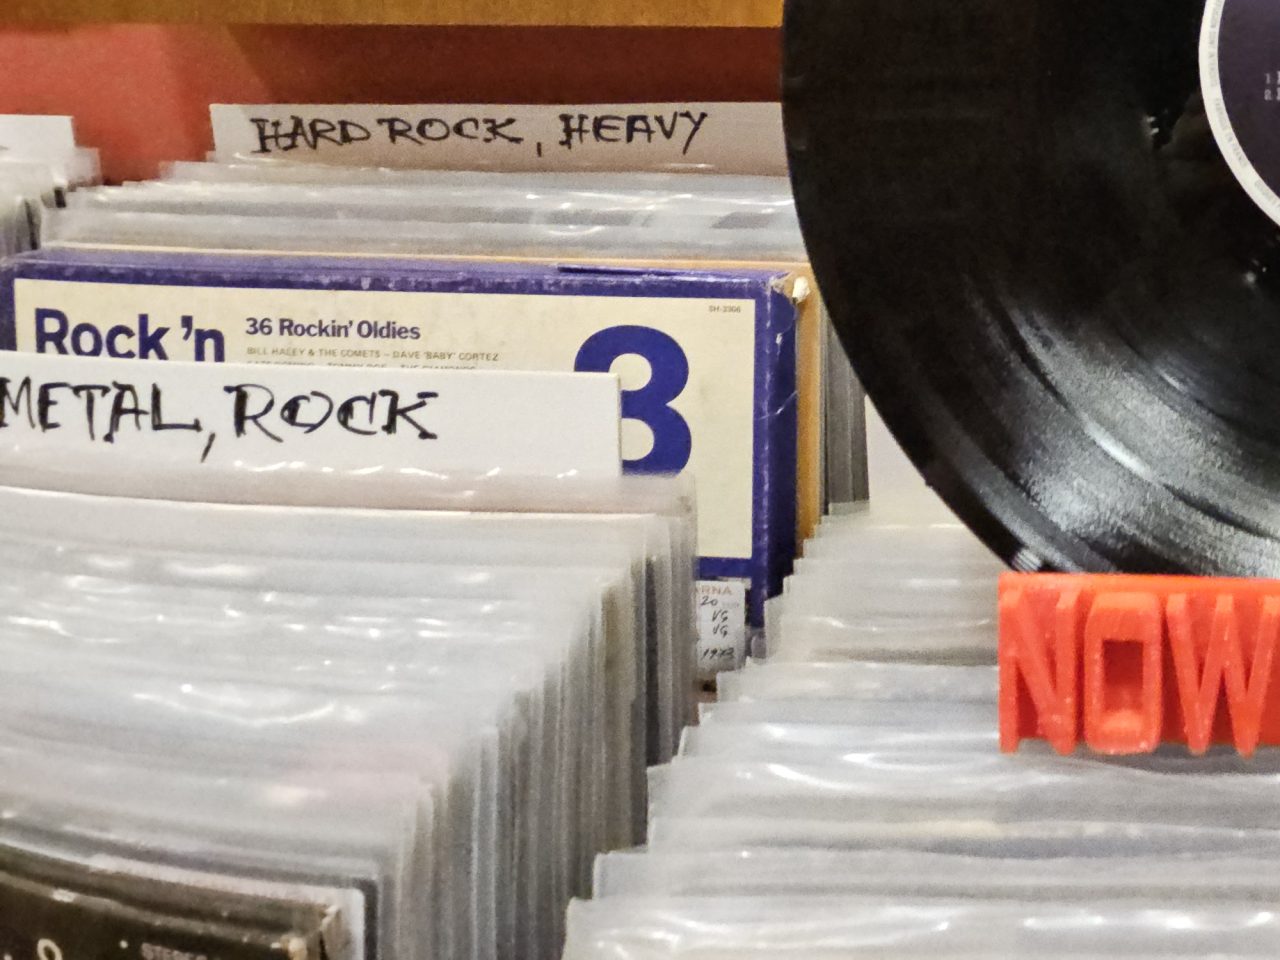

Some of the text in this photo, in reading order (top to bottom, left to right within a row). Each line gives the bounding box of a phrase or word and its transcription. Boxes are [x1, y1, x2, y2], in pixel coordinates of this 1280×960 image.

[249, 115, 371, 153] HARD
[558, 111, 708, 155] HEAVY
[34, 307, 171, 361] Rock
[245, 317, 421, 340] 36 Rockin' Oldies
[247, 347, 269, 356] BILL
[271, 348, 305, 357] HALEY
[318, 348, 338, 357] THE
[340, 349, 381, 359] COMETS
[391, 350, 421, 359] DAVE
[458, 352, 500, 362] CORTEZ
[572, 325, 692, 476] 3
[0, 376, 439, 463] METAL, ROCK
[701, 595, 718, 607] 20
[711, 610, 729, 623] VG
[712, 624, 729, 638] VG
